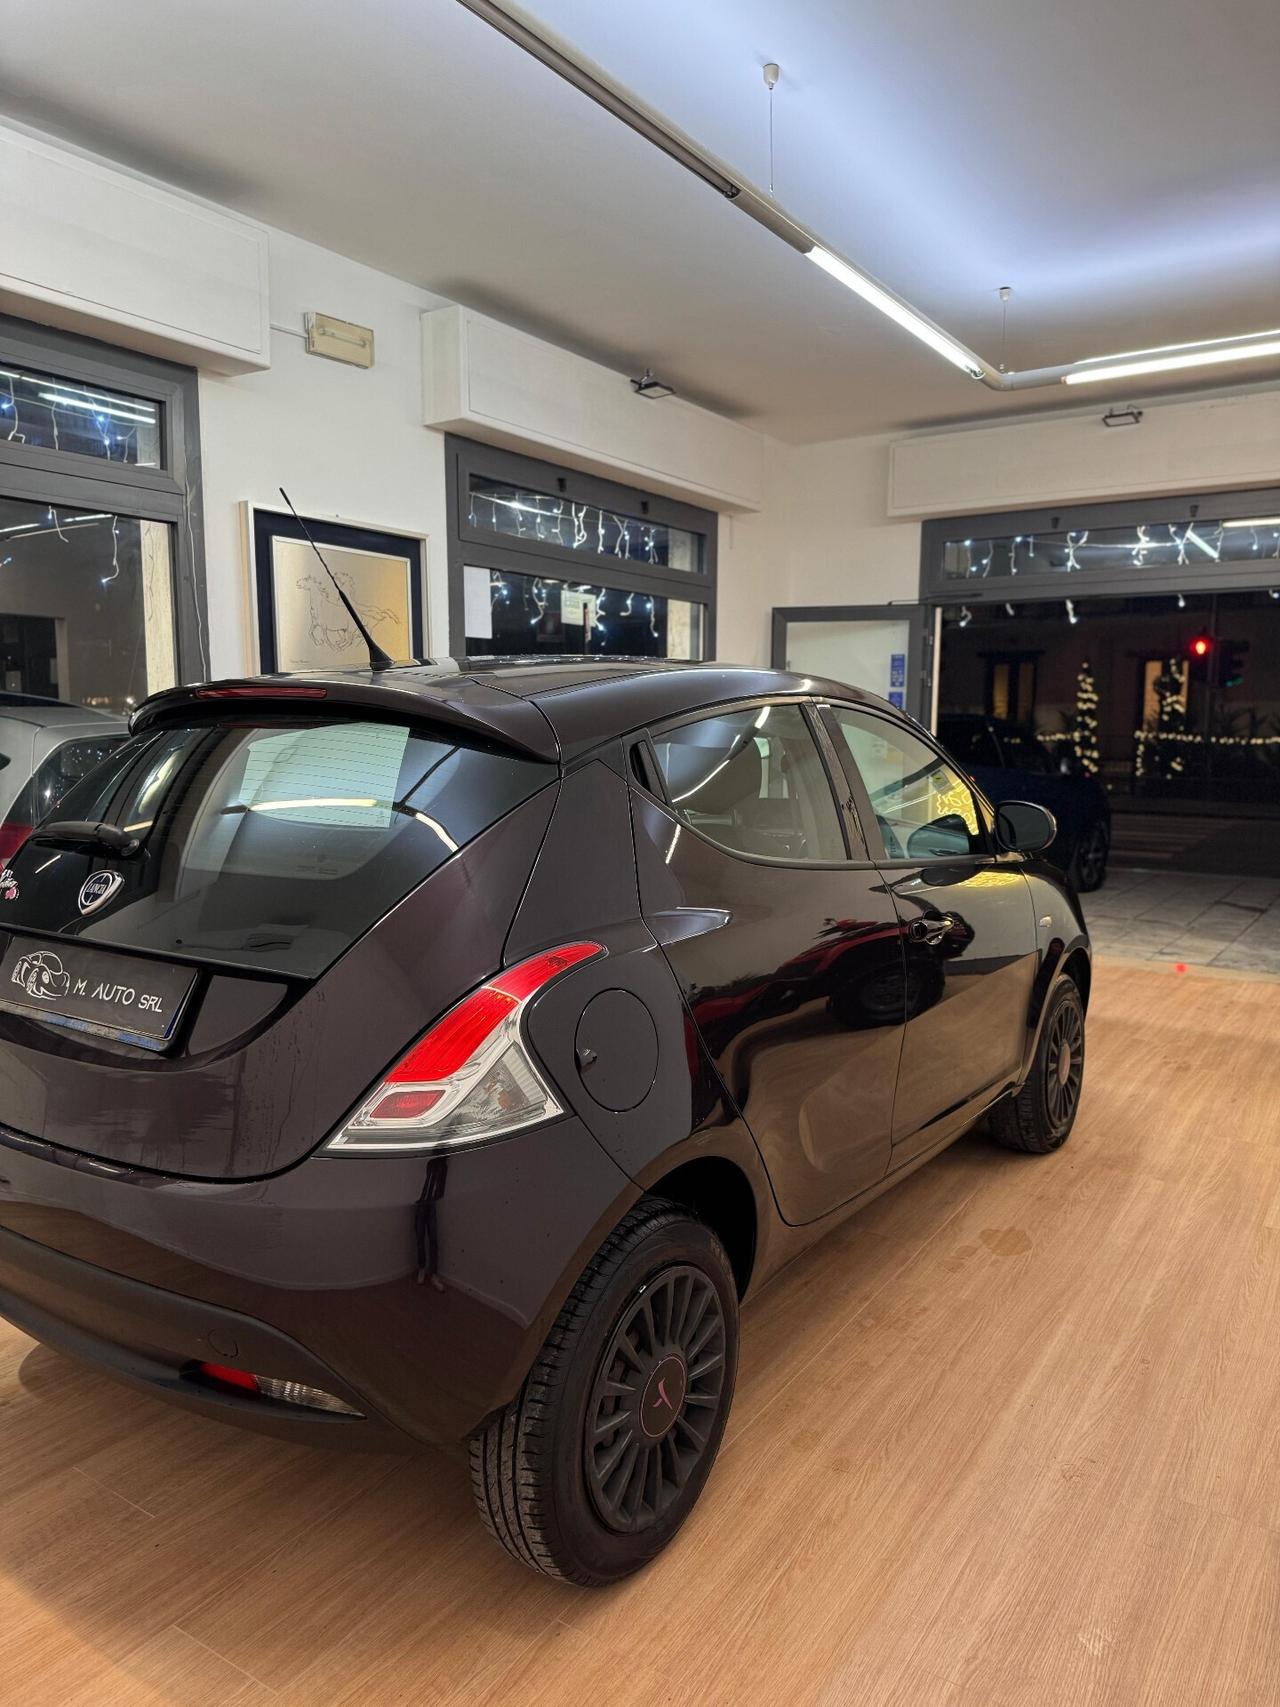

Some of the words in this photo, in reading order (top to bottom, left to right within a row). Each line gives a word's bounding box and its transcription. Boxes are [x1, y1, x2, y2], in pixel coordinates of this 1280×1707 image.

[73, 978, 88, 996] M.
[91, 983, 136, 1006] AUTO
[138, 994, 163, 1013] SRL
